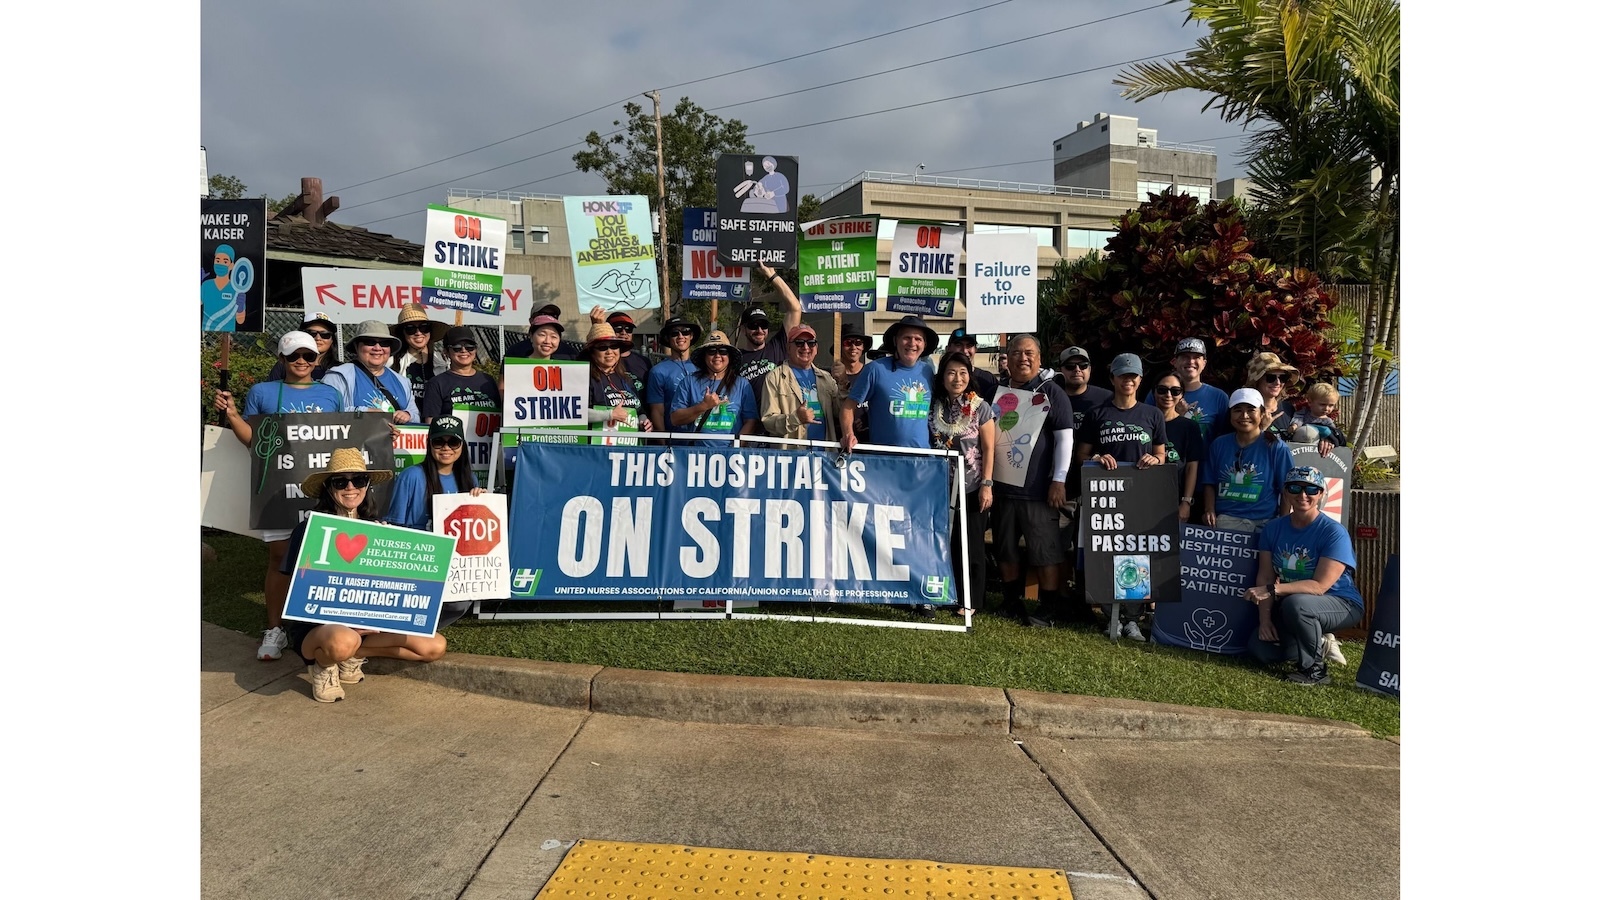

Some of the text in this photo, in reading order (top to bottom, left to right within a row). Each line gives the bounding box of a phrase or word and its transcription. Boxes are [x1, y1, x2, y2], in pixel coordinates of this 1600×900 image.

[583, 201, 617, 212] HONK
[200, 214, 250, 227] WAKE UP,
[597, 215, 624, 226] YOU
[704, 212, 717, 228] FA
[721, 219, 794, 232] SAFE STAFFING
[830, 221, 872, 234] STRIKE
[205, 229, 244, 239] KAISER
[455, 215, 481, 241] ON
[596, 226, 626, 238] LOVE
[692, 229, 717, 242] CONT
[589, 236, 630, 250] CRNAS
[917, 226, 941, 248] ON
[832, 241, 844, 251] for
[435, 241, 498, 270] STRIKE
[732, 249, 786, 262] SAFE CARE
[818, 253, 860, 270] PATIENT
[899, 252, 954, 274] STRIKE
[975, 261, 1031, 277] Failure
[435, 277, 493, 292] Our Professions
[804, 270, 875, 286] CARE and SAFETY
[995, 279, 1012, 291] to
[352, 284, 522, 310] EMERY
[898, 286, 948, 296] Our Professions
[980, 292, 1025, 306] thrive
[533, 366, 562, 391] ON
[514, 396, 582, 420] STRIKE
[287, 425, 351, 440] EQUITY
[1100, 434, 1149, 444] UNAC/UHCP
[278, 454, 294, 470] IS
[608, 452, 866, 492] THIS HOSPITAL IS
[1090, 480, 1124, 492] HONK
[1090, 497, 1116, 508] FOR
[1090, 513, 1125, 530] GAS
[448, 518, 498, 542] STOP
[1185, 527, 1251, 544] PROTECT
[314, 526, 337, 565] I
[373, 538, 435, 552] NURSES AND
[557, 495, 910, 581] ON STRIKE
[1092, 534, 1171, 552] PASSERS
[366, 548, 435, 562] HEALTH CARE
[1180, 540, 1260, 559] NESTHETIST
[359, 558, 439, 573] PROFESSIONALS
[451, 556, 502, 569] CUTTING
[1196, 555, 1233, 569] WHO
[448, 569, 500, 582] PATIENT
[1180, 566, 1246, 584] PROTECT
[328, 576, 417, 591] TELL KAISER PERMANENTE:
[450, 581, 497, 594] SAFETY!
[308, 586, 431, 609] FAIR CONTRACT NOW
[622, 587, 684, 595] ASSOCIATIONS
[698, 588, 778, 596] CALIFORNIA/UNION
[792, 588, 822, 596] HEALTH
[823, 589, 844, 597] CARE
[845, 590, 908, 598] PROFESSIONALS
